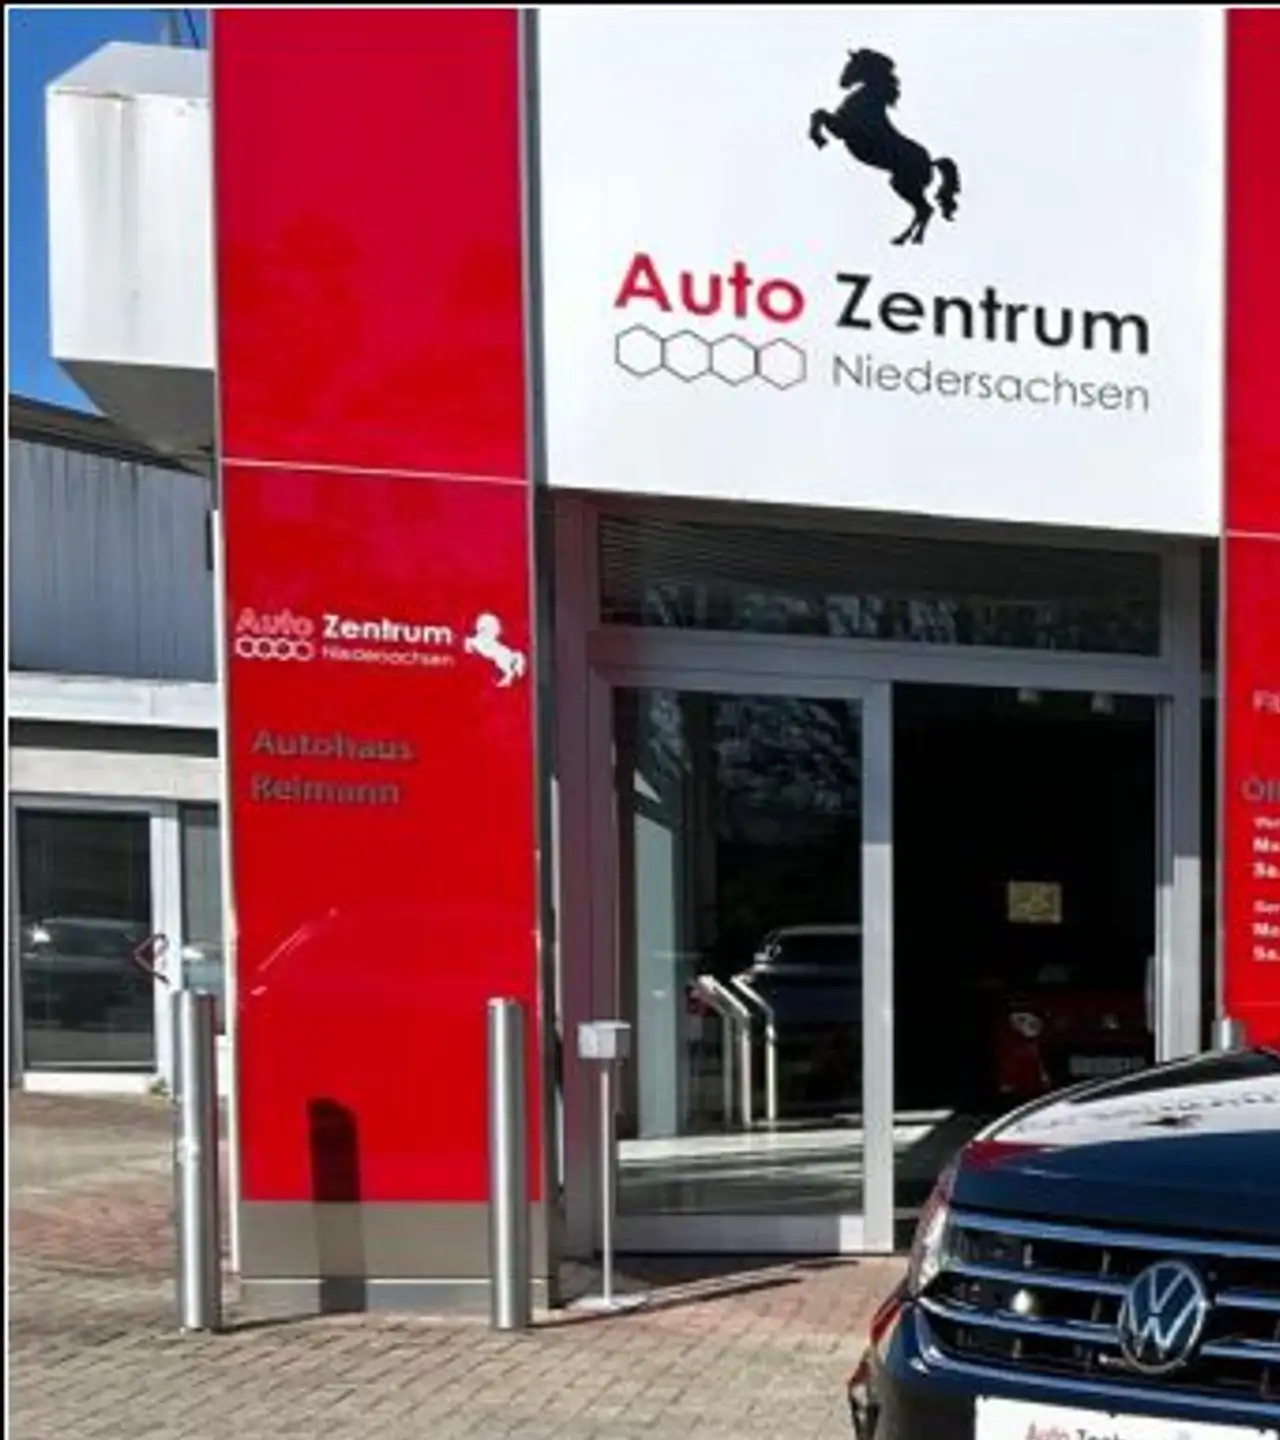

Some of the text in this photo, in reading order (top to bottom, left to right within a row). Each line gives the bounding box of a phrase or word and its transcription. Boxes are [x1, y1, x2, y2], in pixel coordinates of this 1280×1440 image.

[613, 253, 1150, 355] Auto Zentrum
[832, 354, 1150, 411] Niedersachsen
[236, 607, 454, 645] Auto Zentrum
[252, 730, 416, 761] Autohaus
[252, 774, 399, 805] Reimann
